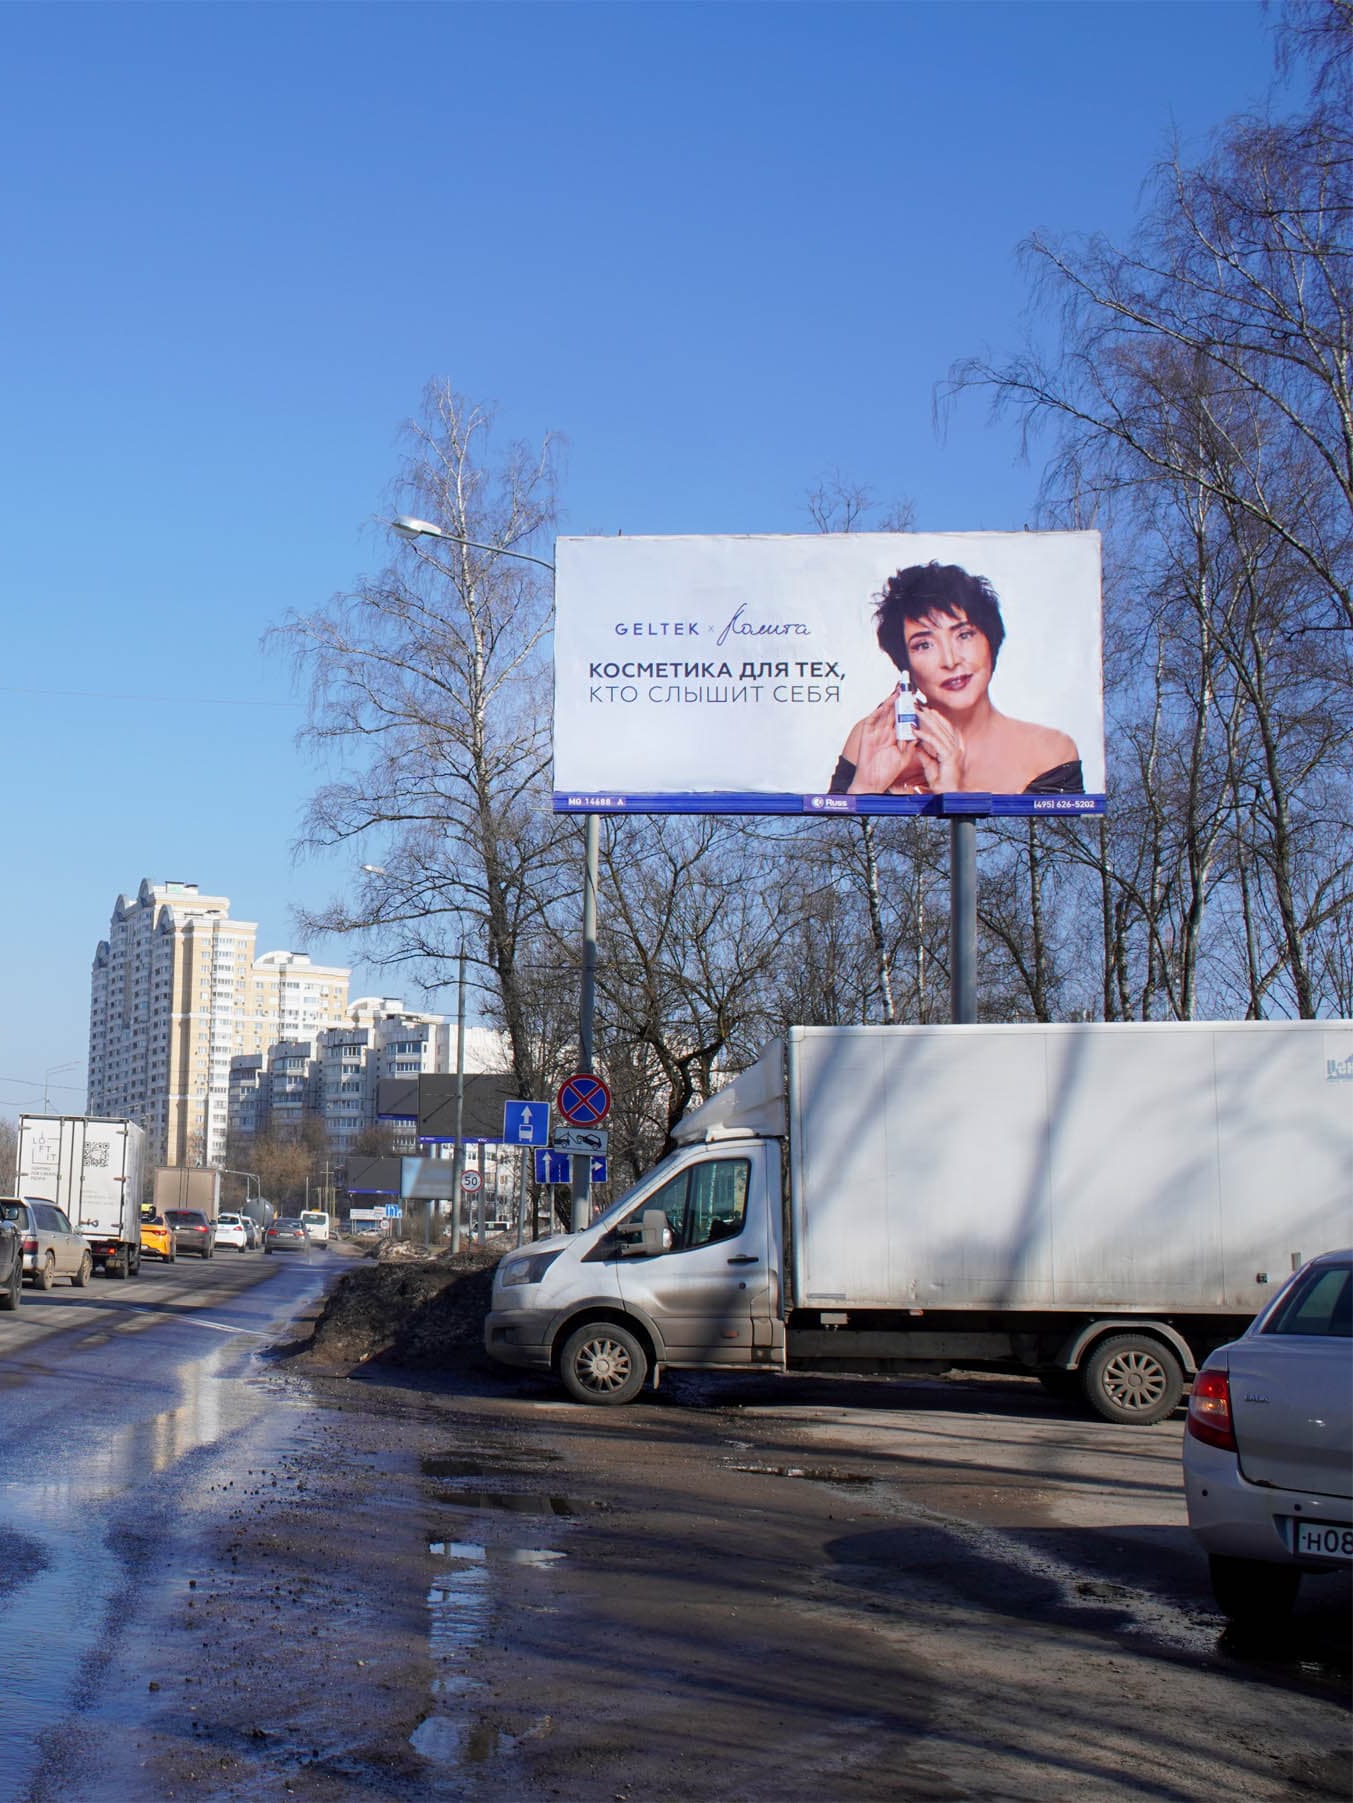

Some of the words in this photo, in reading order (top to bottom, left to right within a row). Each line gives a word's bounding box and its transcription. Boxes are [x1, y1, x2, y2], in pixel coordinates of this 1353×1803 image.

[615, 622, 699, 636] GELTEK
[589, 662, 733, 678] КОСМЕТИКА
[739, 662, 789, 680] ДЛЯ
[795, 662, 846, 680] ТЕХ,
[589, 686, 638, 703] КТО
[648, 686, 765, 703] СЛЫШИТ
[773, 686, 840, 703] СЕБЯ
[825, 798, 847, 806] Russ
[1033, 800, 1054, 808] (495)
[1056, 800, 1095, 809] 626-5202
[464, 1176, 478, 1186] 50
